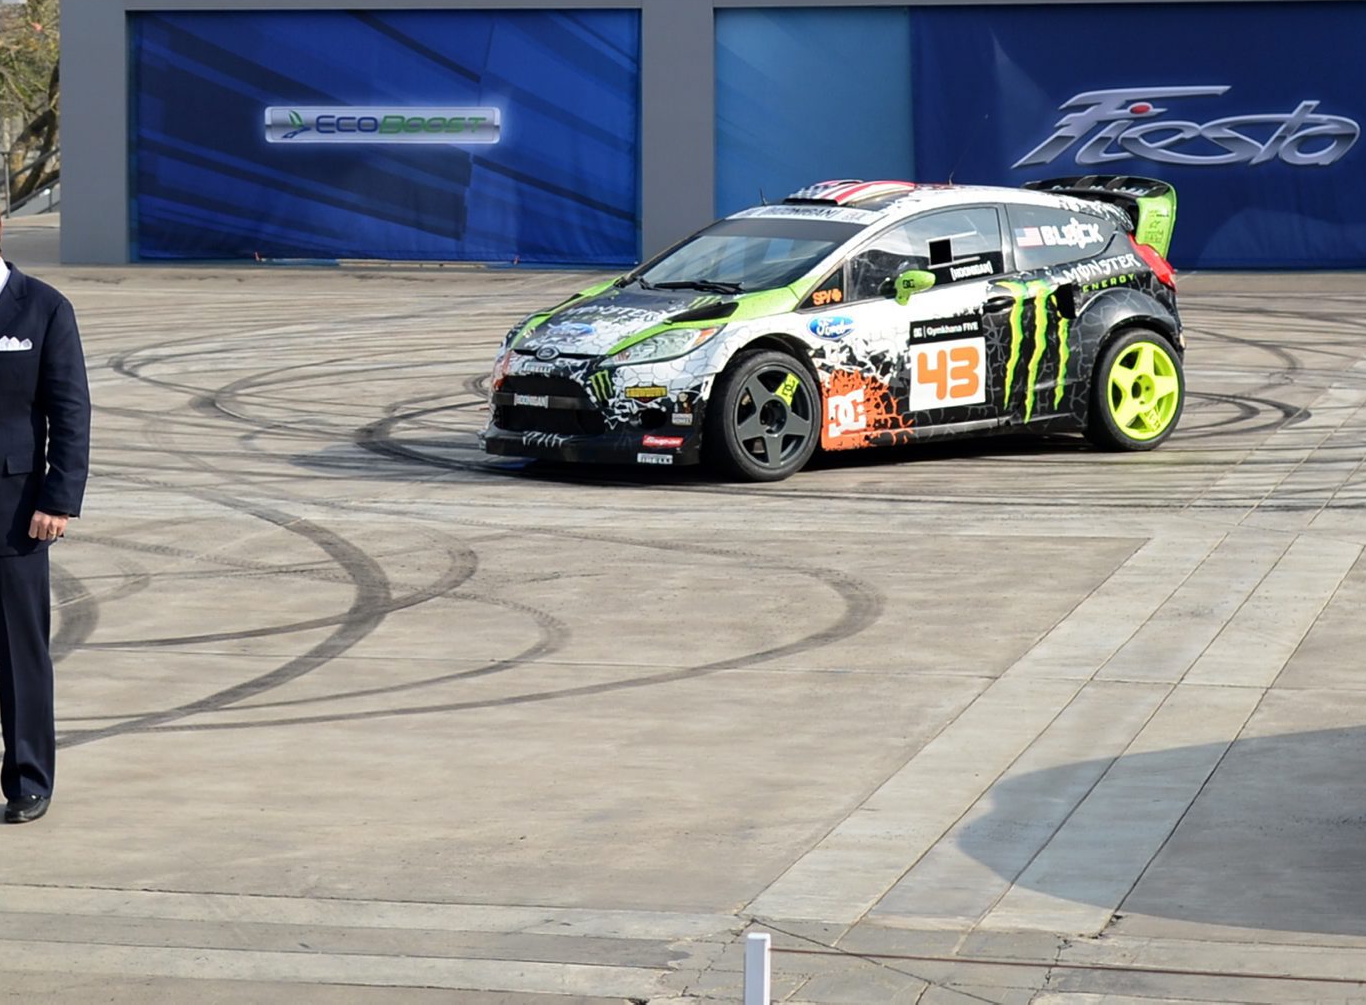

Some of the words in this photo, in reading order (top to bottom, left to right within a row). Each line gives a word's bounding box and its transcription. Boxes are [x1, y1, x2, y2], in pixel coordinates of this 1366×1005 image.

[1011, 85, 1360, 169] Fiesta
[1062, 254, 1142, 282] MONSTER
[1082, 273, 1135, 293] ENERGY
[816, 315, 853, 337] Ford
[962, 321, 979, 332] FIVE
[917, 346, 980, 401] 43
[827, 388, 867, 438] DC
